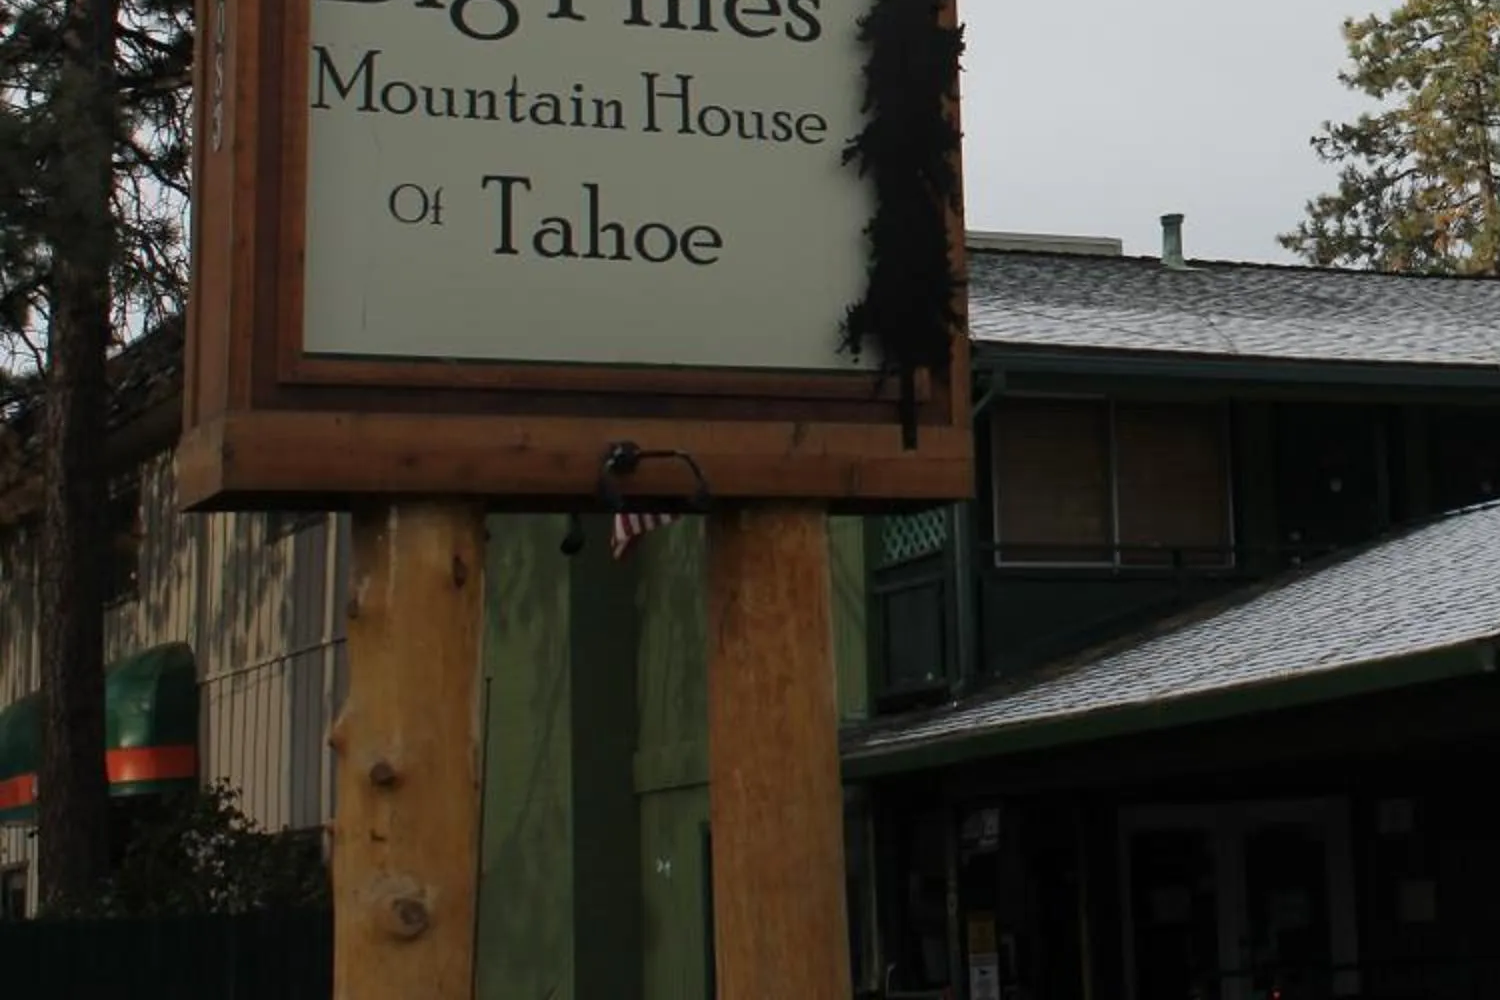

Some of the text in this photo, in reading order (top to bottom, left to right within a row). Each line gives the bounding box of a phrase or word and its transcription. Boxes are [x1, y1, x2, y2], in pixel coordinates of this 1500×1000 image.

[311, 45, 828, 145] Mountain House
[388, 174, 723, 266] Of Tahoe
